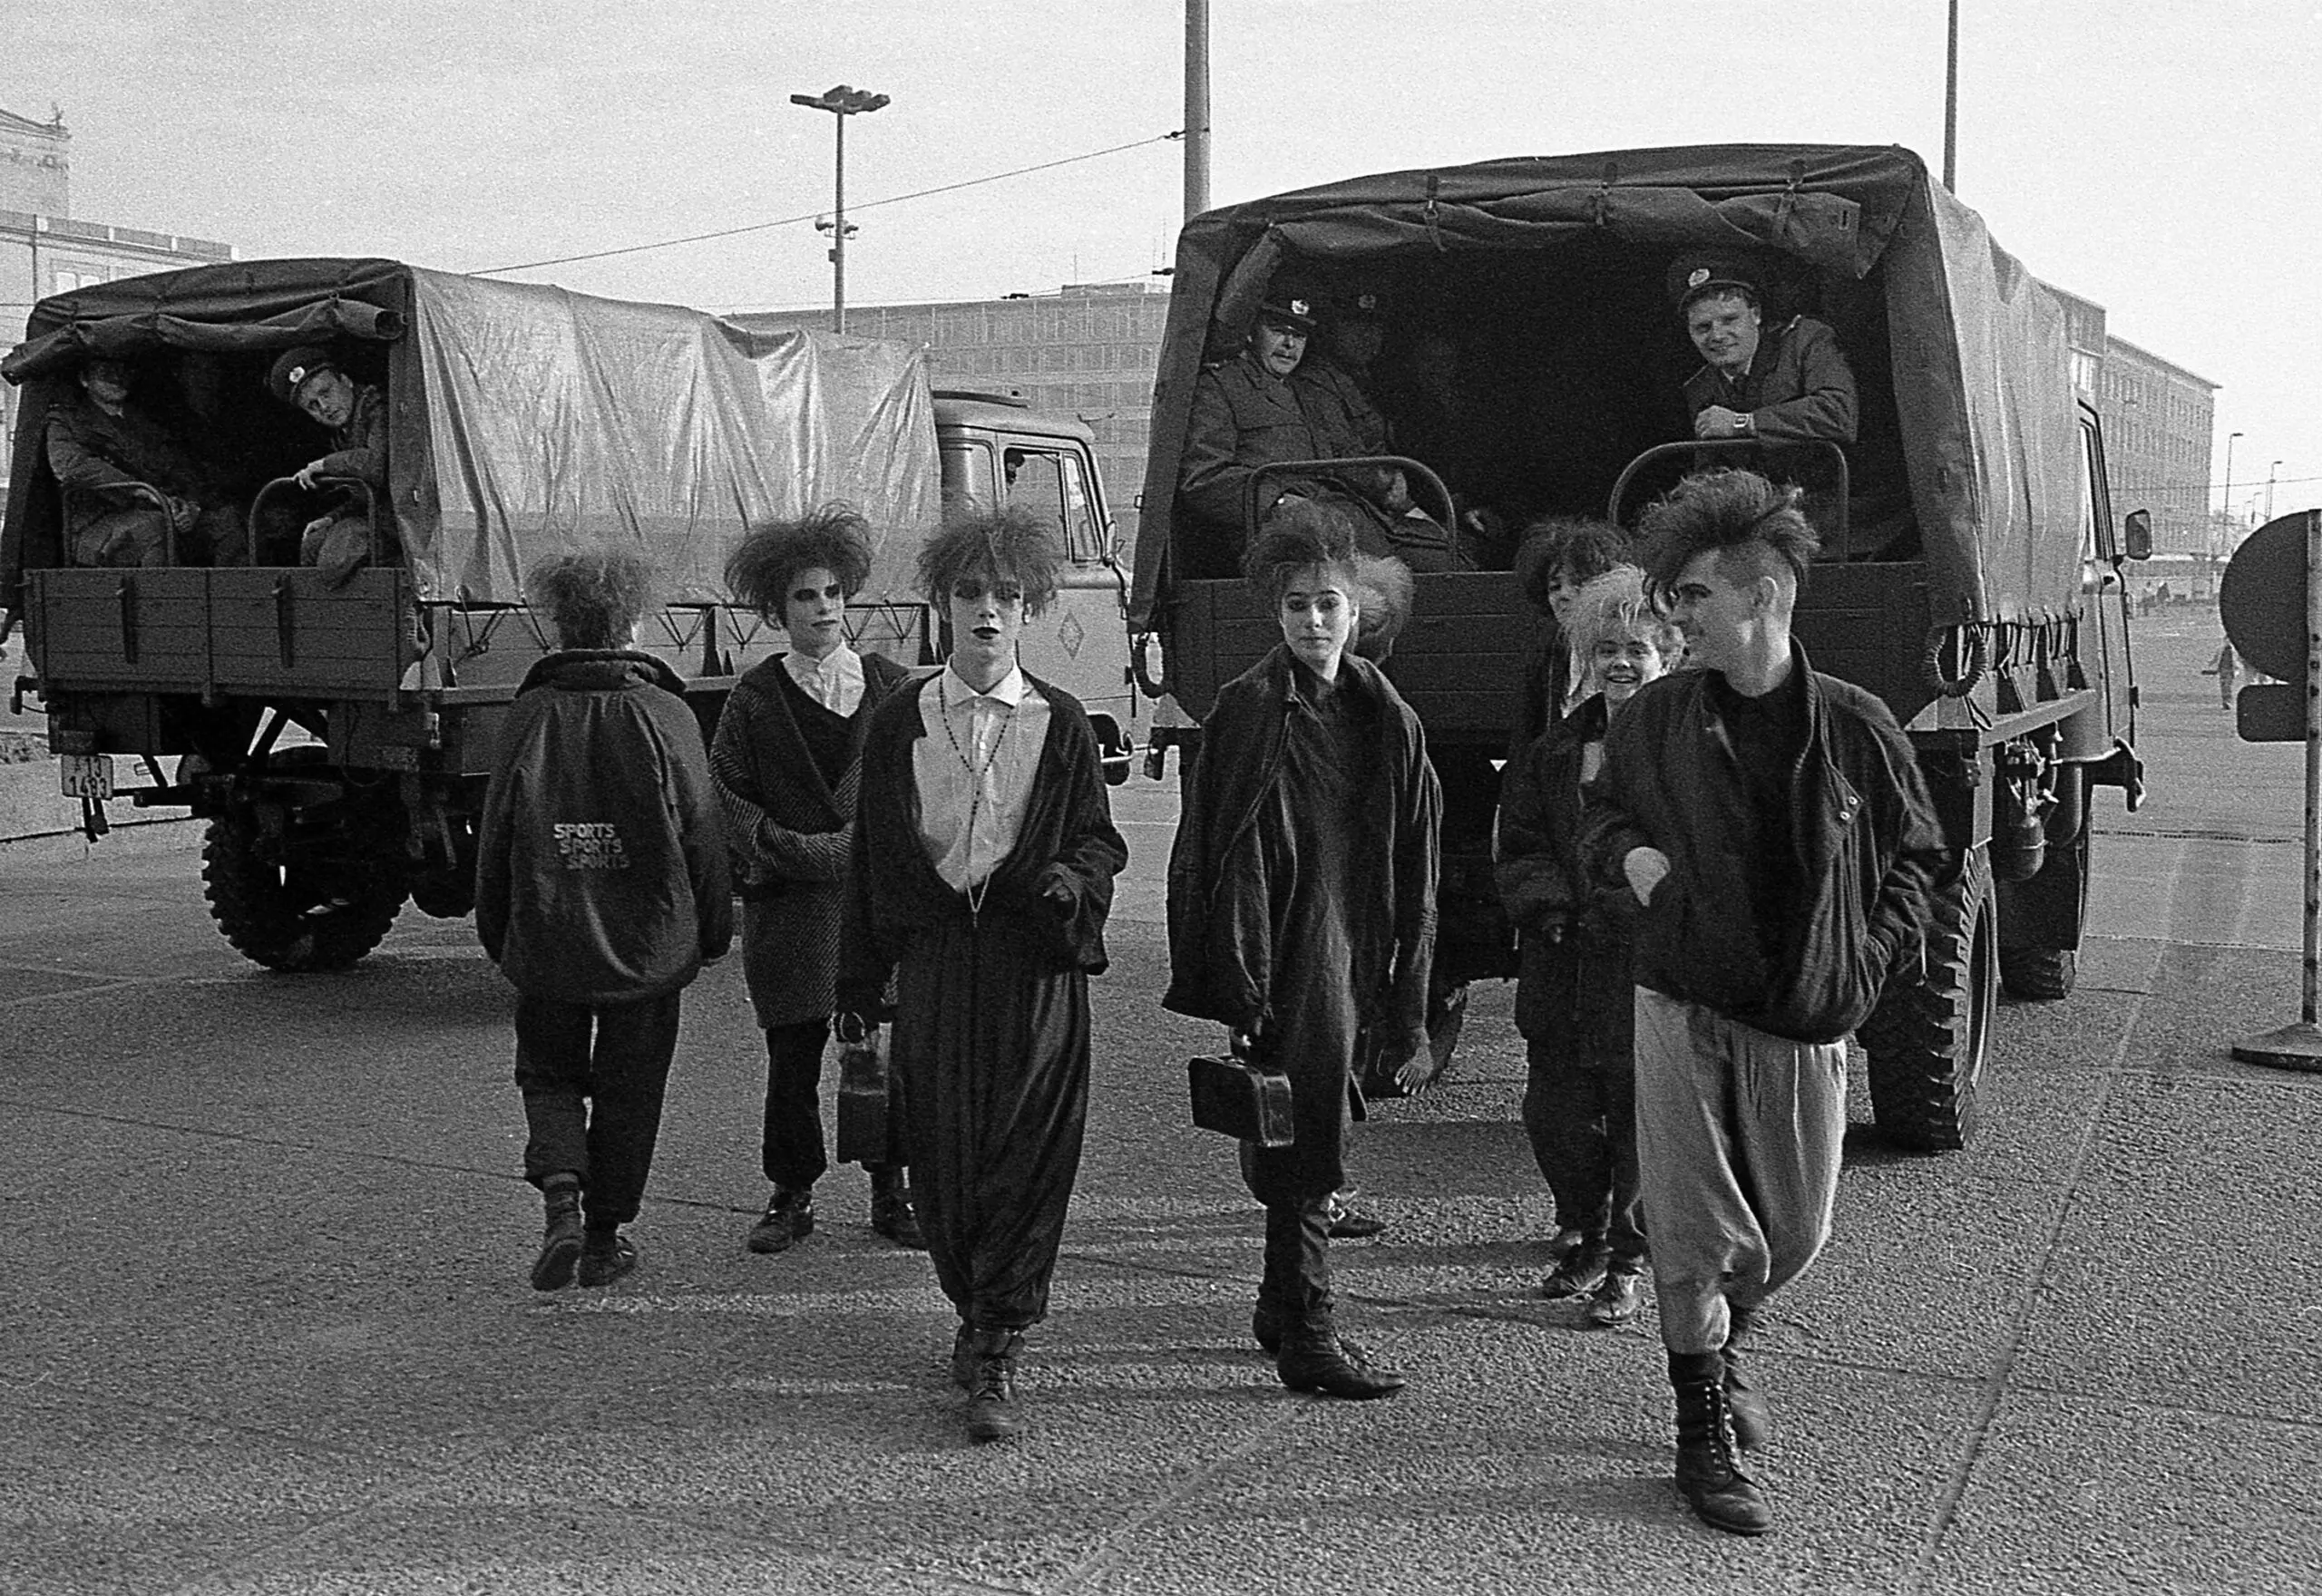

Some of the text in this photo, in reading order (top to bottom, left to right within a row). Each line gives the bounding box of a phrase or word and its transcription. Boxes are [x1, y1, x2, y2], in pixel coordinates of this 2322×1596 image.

[553, 822, 615, 839] SPORTS
[559, 838, 623, 854] SPORTS
[566, 853, 630, 870] SPORTS
